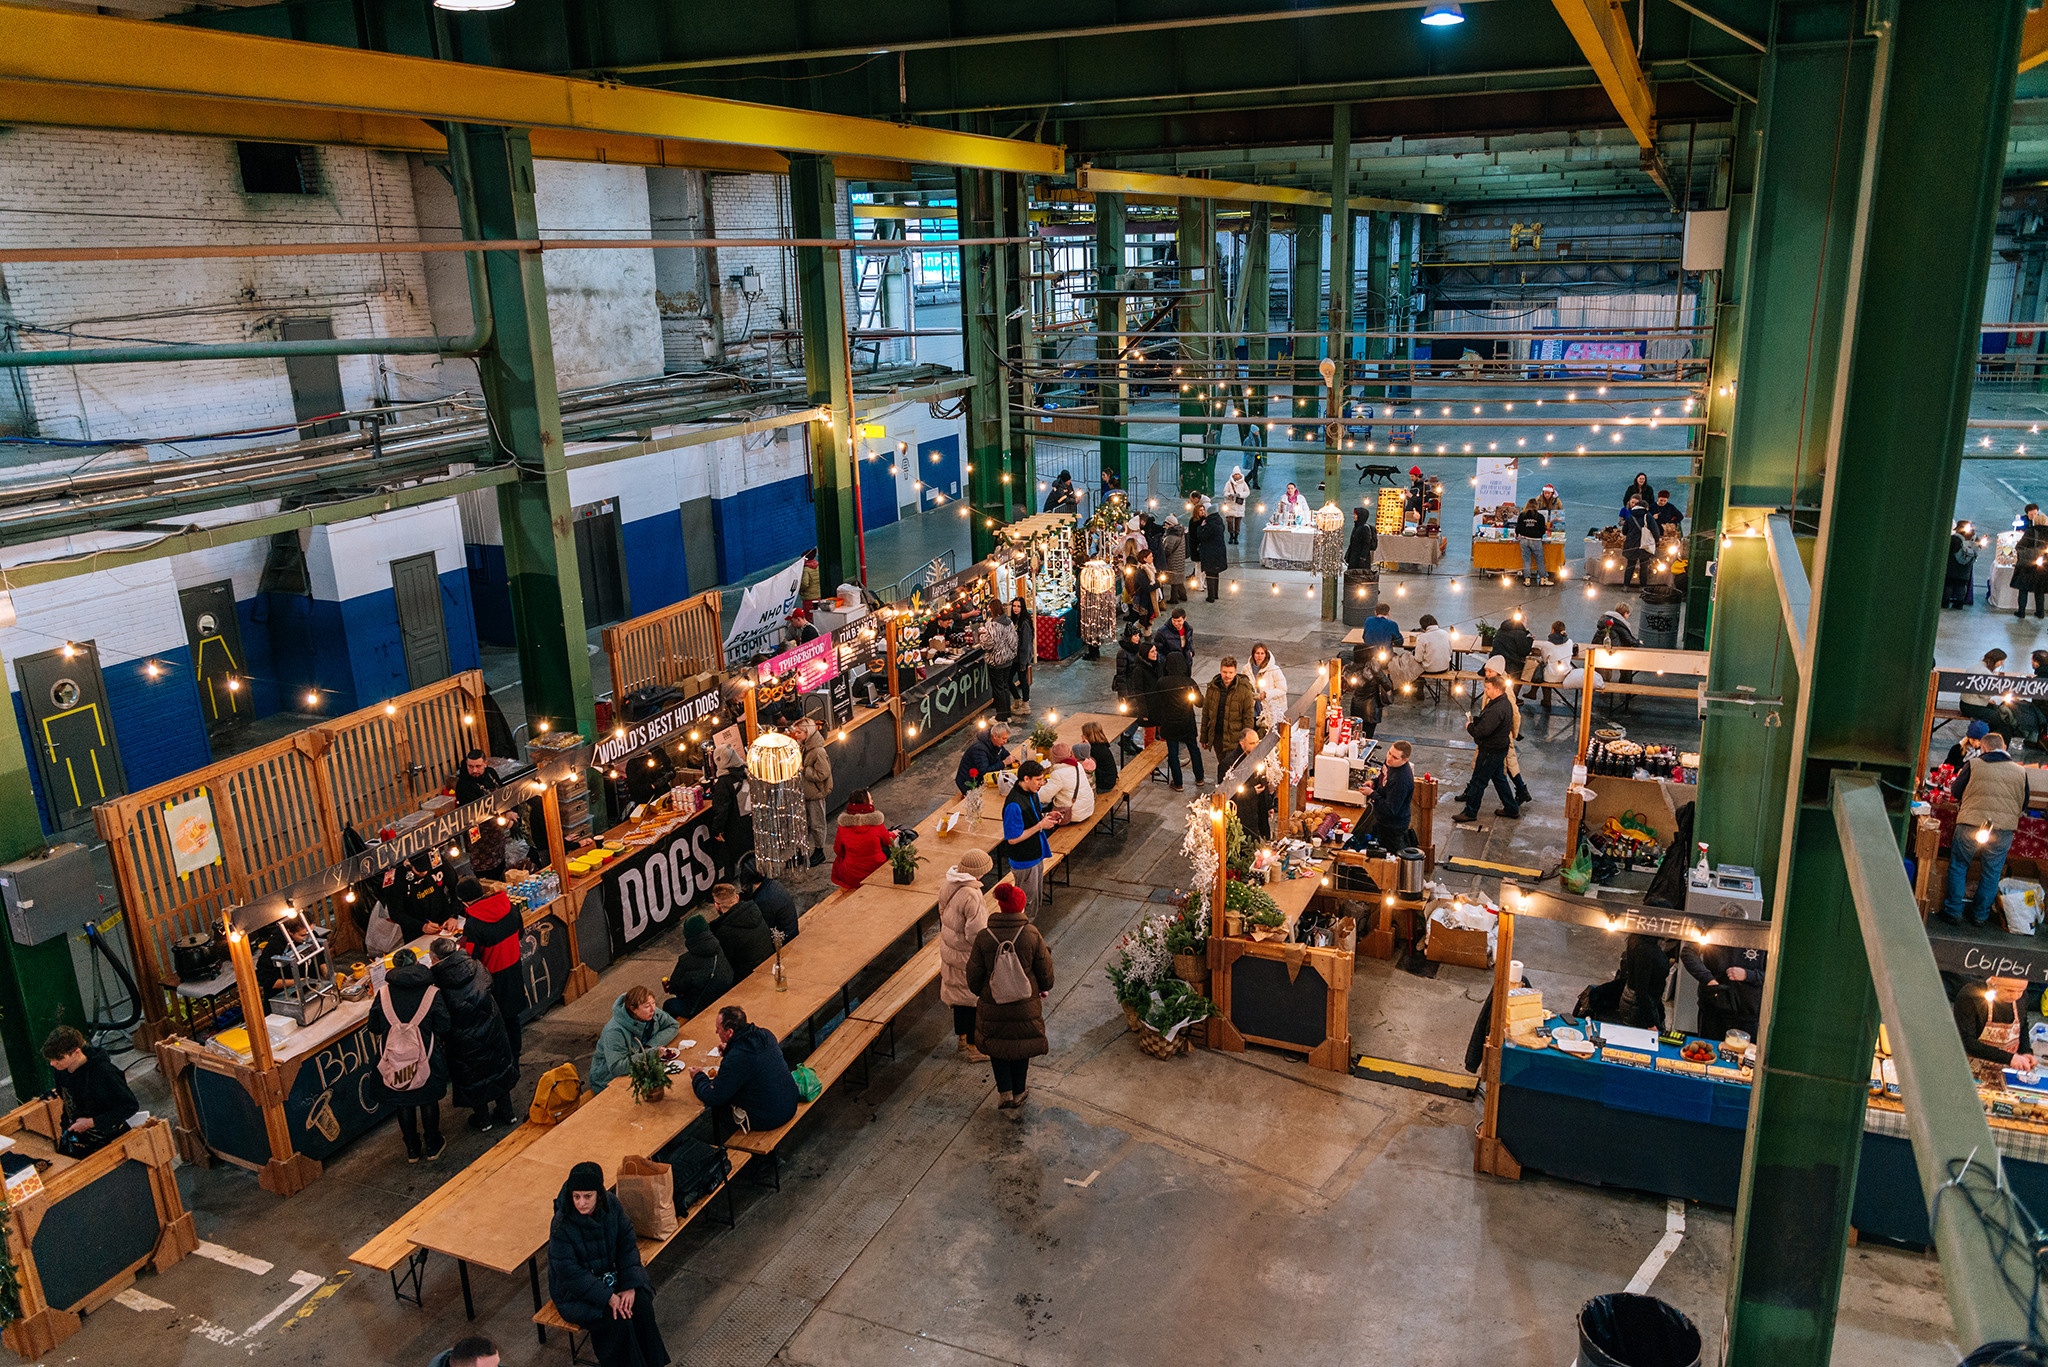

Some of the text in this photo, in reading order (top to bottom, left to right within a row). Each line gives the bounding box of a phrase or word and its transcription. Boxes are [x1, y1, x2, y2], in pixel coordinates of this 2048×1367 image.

[778, 642, 825, 672] ТРИДЕВЯТОЕ
[598, 690, 720, 765] WORLD'S BEST HOT DOGS
[920, 663, 989, 733] Я ФРИ
[376, 794, 497, 869] СУПСТАНЦИЯ
[1964, 947, 2032, 977] Сыры
